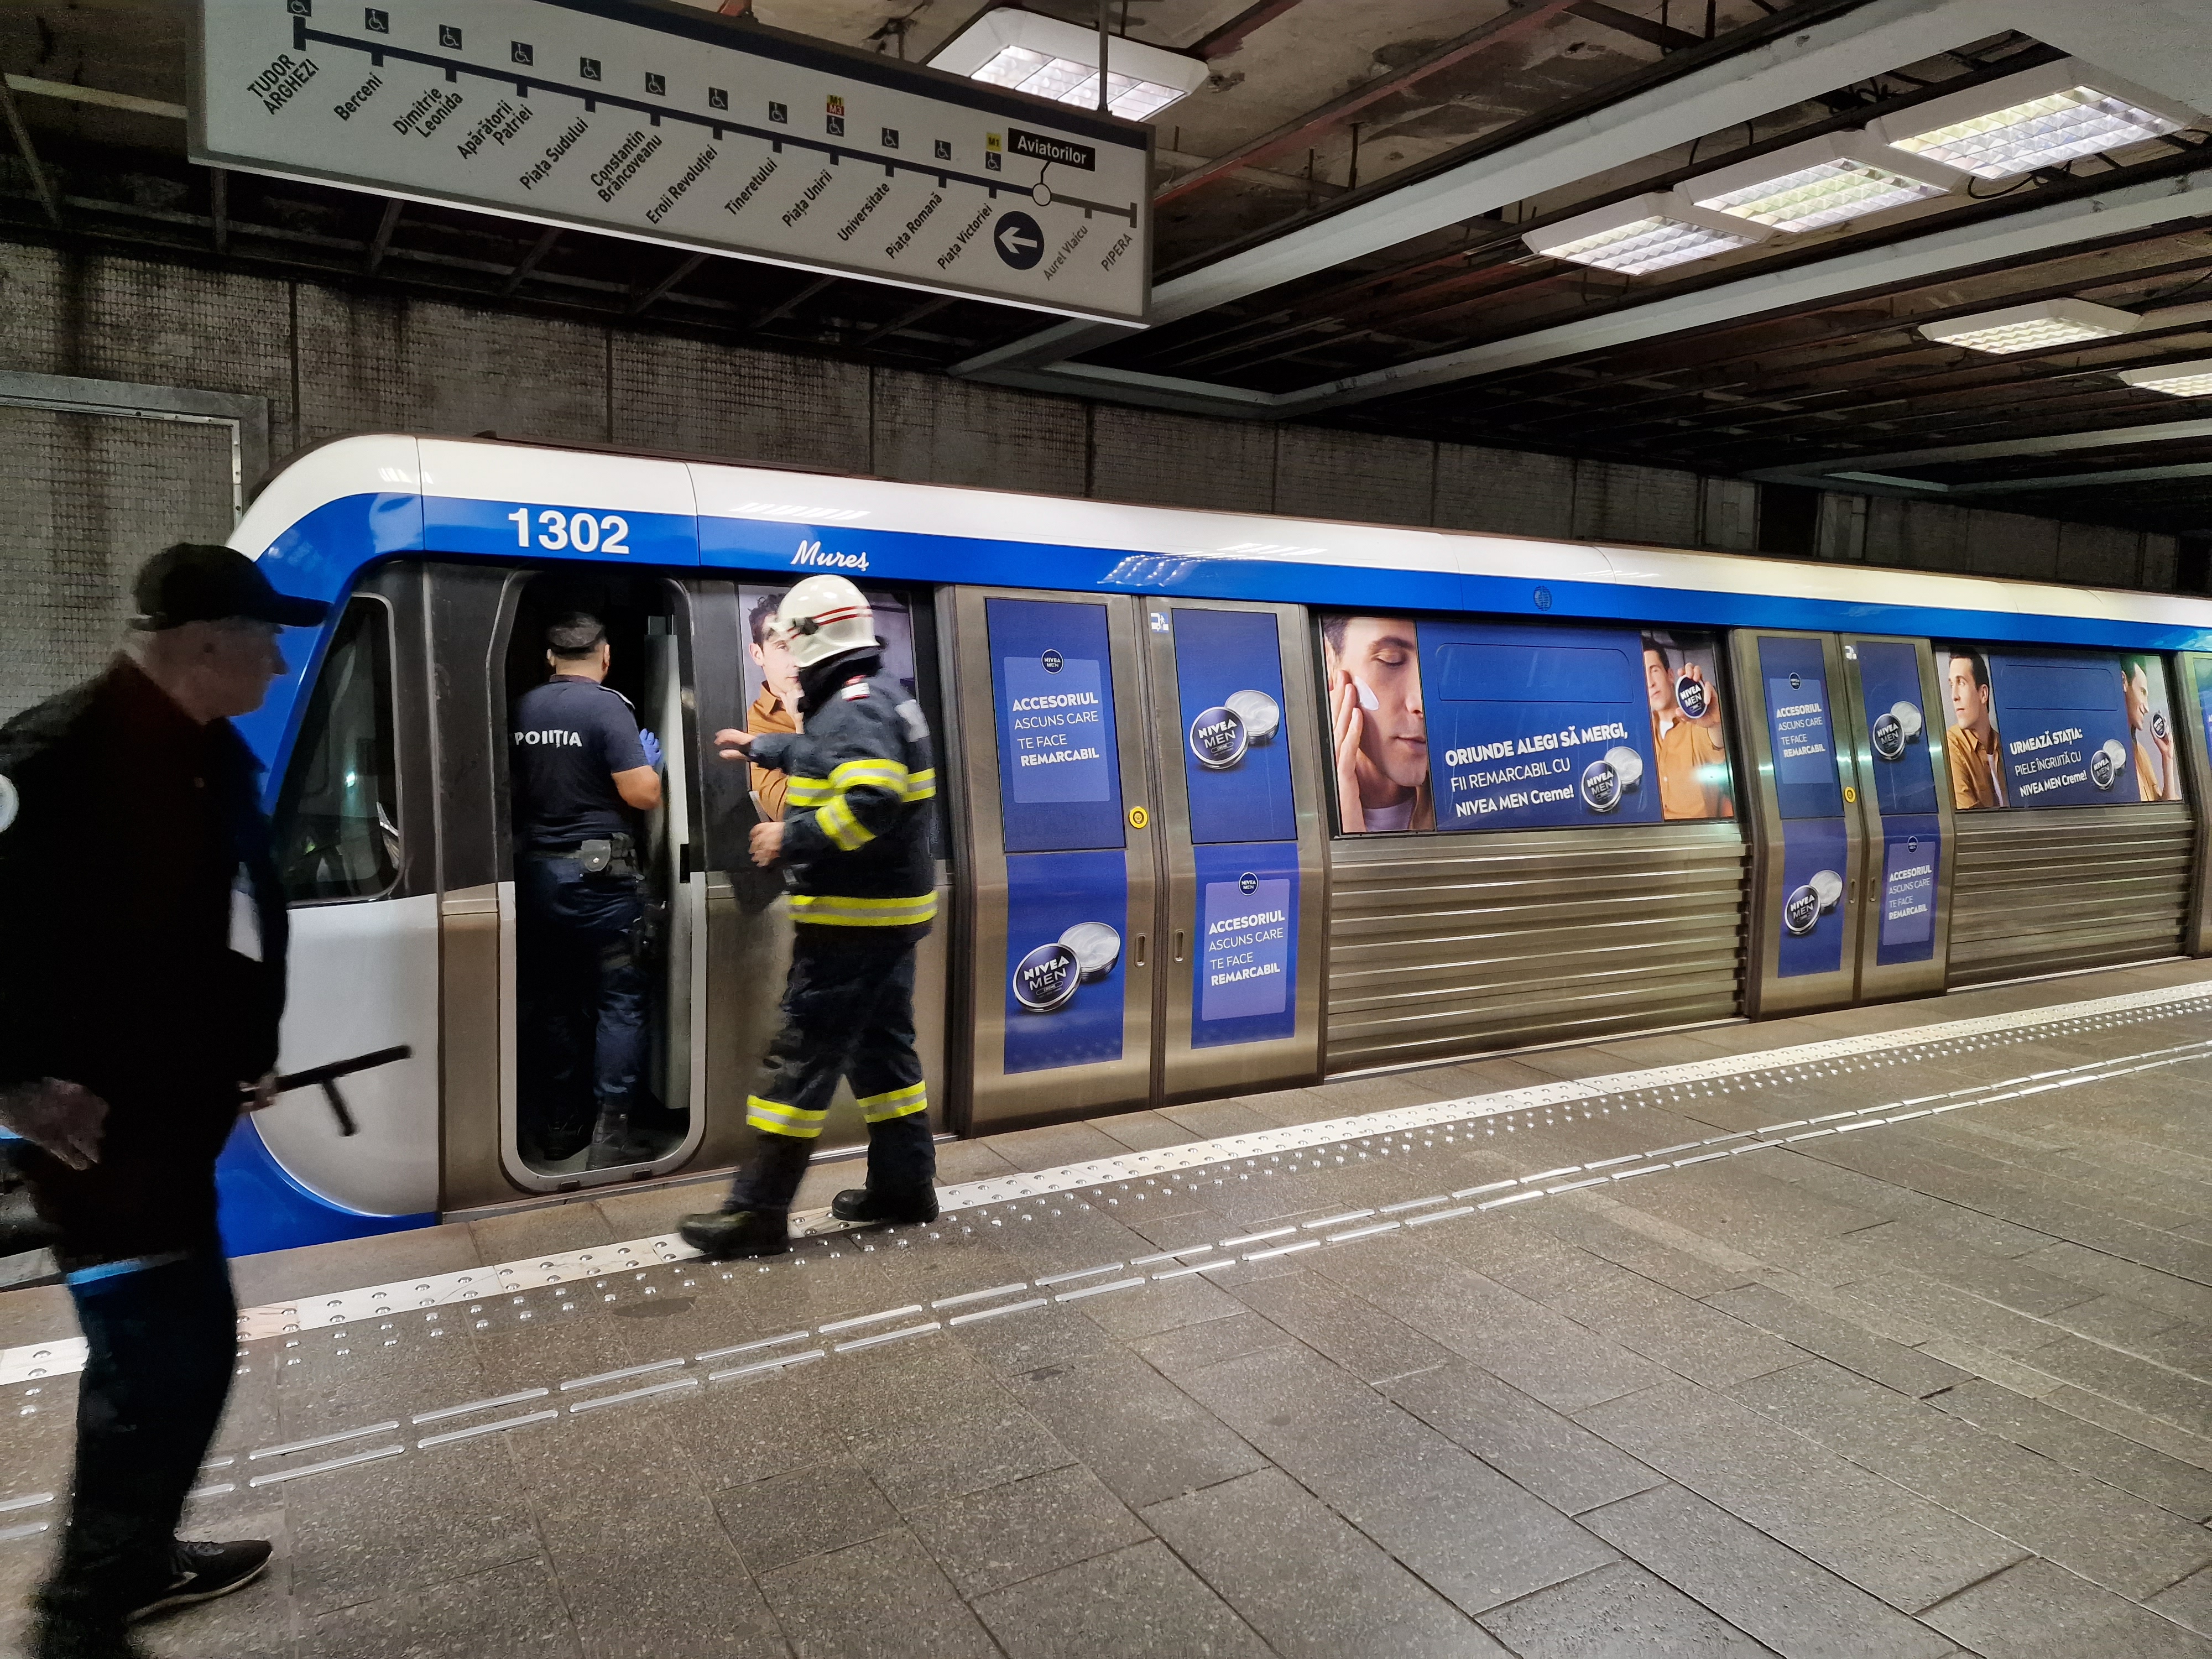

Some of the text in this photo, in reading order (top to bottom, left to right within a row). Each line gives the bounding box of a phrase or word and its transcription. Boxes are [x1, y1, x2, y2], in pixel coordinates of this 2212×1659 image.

[246, 54, 296, 98] TUDOR
[262, 58, 319, 115] ARGHEZI
[333, 72, 383, 121] Berceni
[392, 87, 442, 135] Dimitrie
[415, 92, 463, 138] Leonida
[457, 100, 513, 159] Apărătorii
[492, 104, 533, 146] Patriei
[546, 117, 588, 162] Sudului
[988, 137, 999, 147] M1
[1018, 135, 1086, 164] Aviatorilor
[590, 130, 645, 187] Constantin
[597, 135, 662, 203] Brâncoveanu
[724, 156, 778, 216] Tineretului
[804, 169, 833, 202] Unirii
[645, 194, 674, 225] Eroii
[837, 182, 890, 242] Universitate
[907, 191, 942, 232] Romană
[957, 203, 993, 244] Victoriei
[1043, 225, 1089, 281] Aurel Vlaicu
[1101, 233, 1133, 272] PIPERA
[508, 507, 630, 554] 1302
[1012, 692, 1098, 712] ACCESORIUL
[1680, 684, 1702, 700] NIVEA
[1684, 693, 1702, 707] MEN
[1014, 711, 1099, 730] ASCUNS CARE
[1776, 703, 1822, 718] ACCESORIUL
[1198, 718, 1237, 739] NIVEA
[1778, 716, 1823, 731] ASCUNS CARE
[1877, 723, 1899, 738] NIVEA
[1018, 734, 1067, 749] TE FACE
[1204, 729, 1236, 749] MEN
[1445, 722, 1629, 766] ORIUNDE ALEGI SĂ MERGI,
[1781, 734, 1807, 745] TE FACE
[1881, 731, 1899, 744] MEN
[2010, 730, 2052, 755] URMEAZĂ
[1021, 747, 1099, 767] REMARCABIL
[1783, 743, 1825, 758] REMARCABIL
[1450, 757, 1571, 792] FII REMARCABIL CU
[2015, 764, 2036, 776] PIELE
[2071, 751, 2082, 763] CU
[1587, 770, 1614, 787] NIVEA
[1591, 779, 1614, 795] MEN
[2019, 784, 2044, 797] NIVEA
[2044, 779, 2062, 791] MEN
[2062, 769, 2088, 786] Creme!
[1455, 784, 1574, 817] NIVEA MEN Creme!
[1889, 865, 1932, 883] ACCESORIUL
[1889, 878, 1931, 895] ASCUNS CARE
[1790, 894, 1815, 912] NIVEA
[1793, 902, 1813, 919] MEN
[1888, 904, 1928, 921] REMARCABIL
[1889, 895, 1913, 908] TE FACE
[1208, 910, 1285, 935] ACCESORIUL
[1208, 927, 1284, 952] ASCUNS CARE
[1024, 956, 1070, 981] NIVEA
[1210, 952, 1254, 970] TE FACE
[1029, 967, 1067, 991] MEN
[1211, 962, 1280, 986] REMARCABIL
